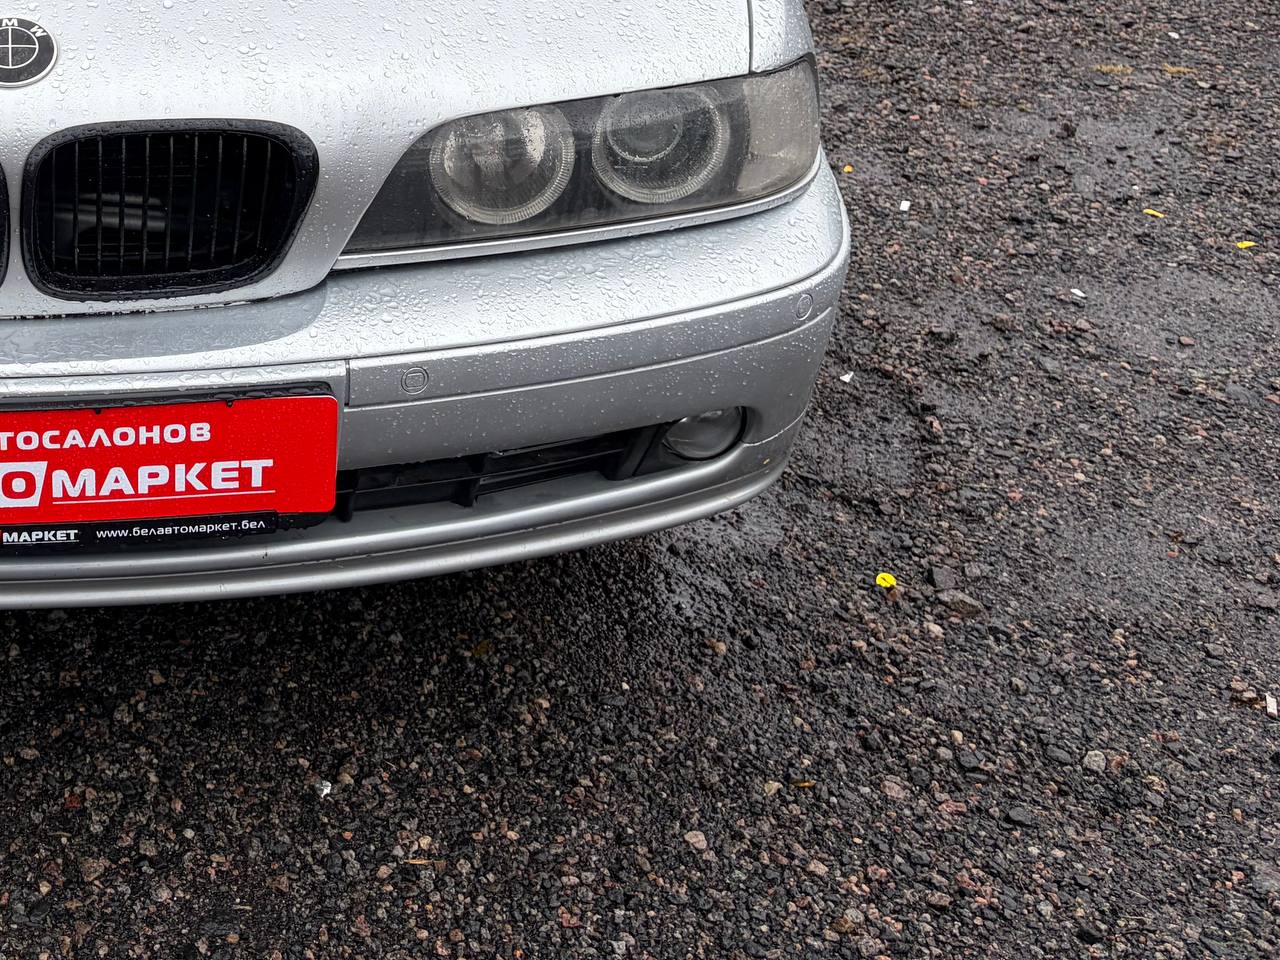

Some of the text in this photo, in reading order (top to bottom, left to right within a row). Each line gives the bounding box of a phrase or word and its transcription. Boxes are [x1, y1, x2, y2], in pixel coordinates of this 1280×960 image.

[52, 459, 274, 498] МАРКЕТ
[3, 529, 78, 542] МАРКЕТ
[96, 520, 266, 539] www.белавтомаркет.бел
